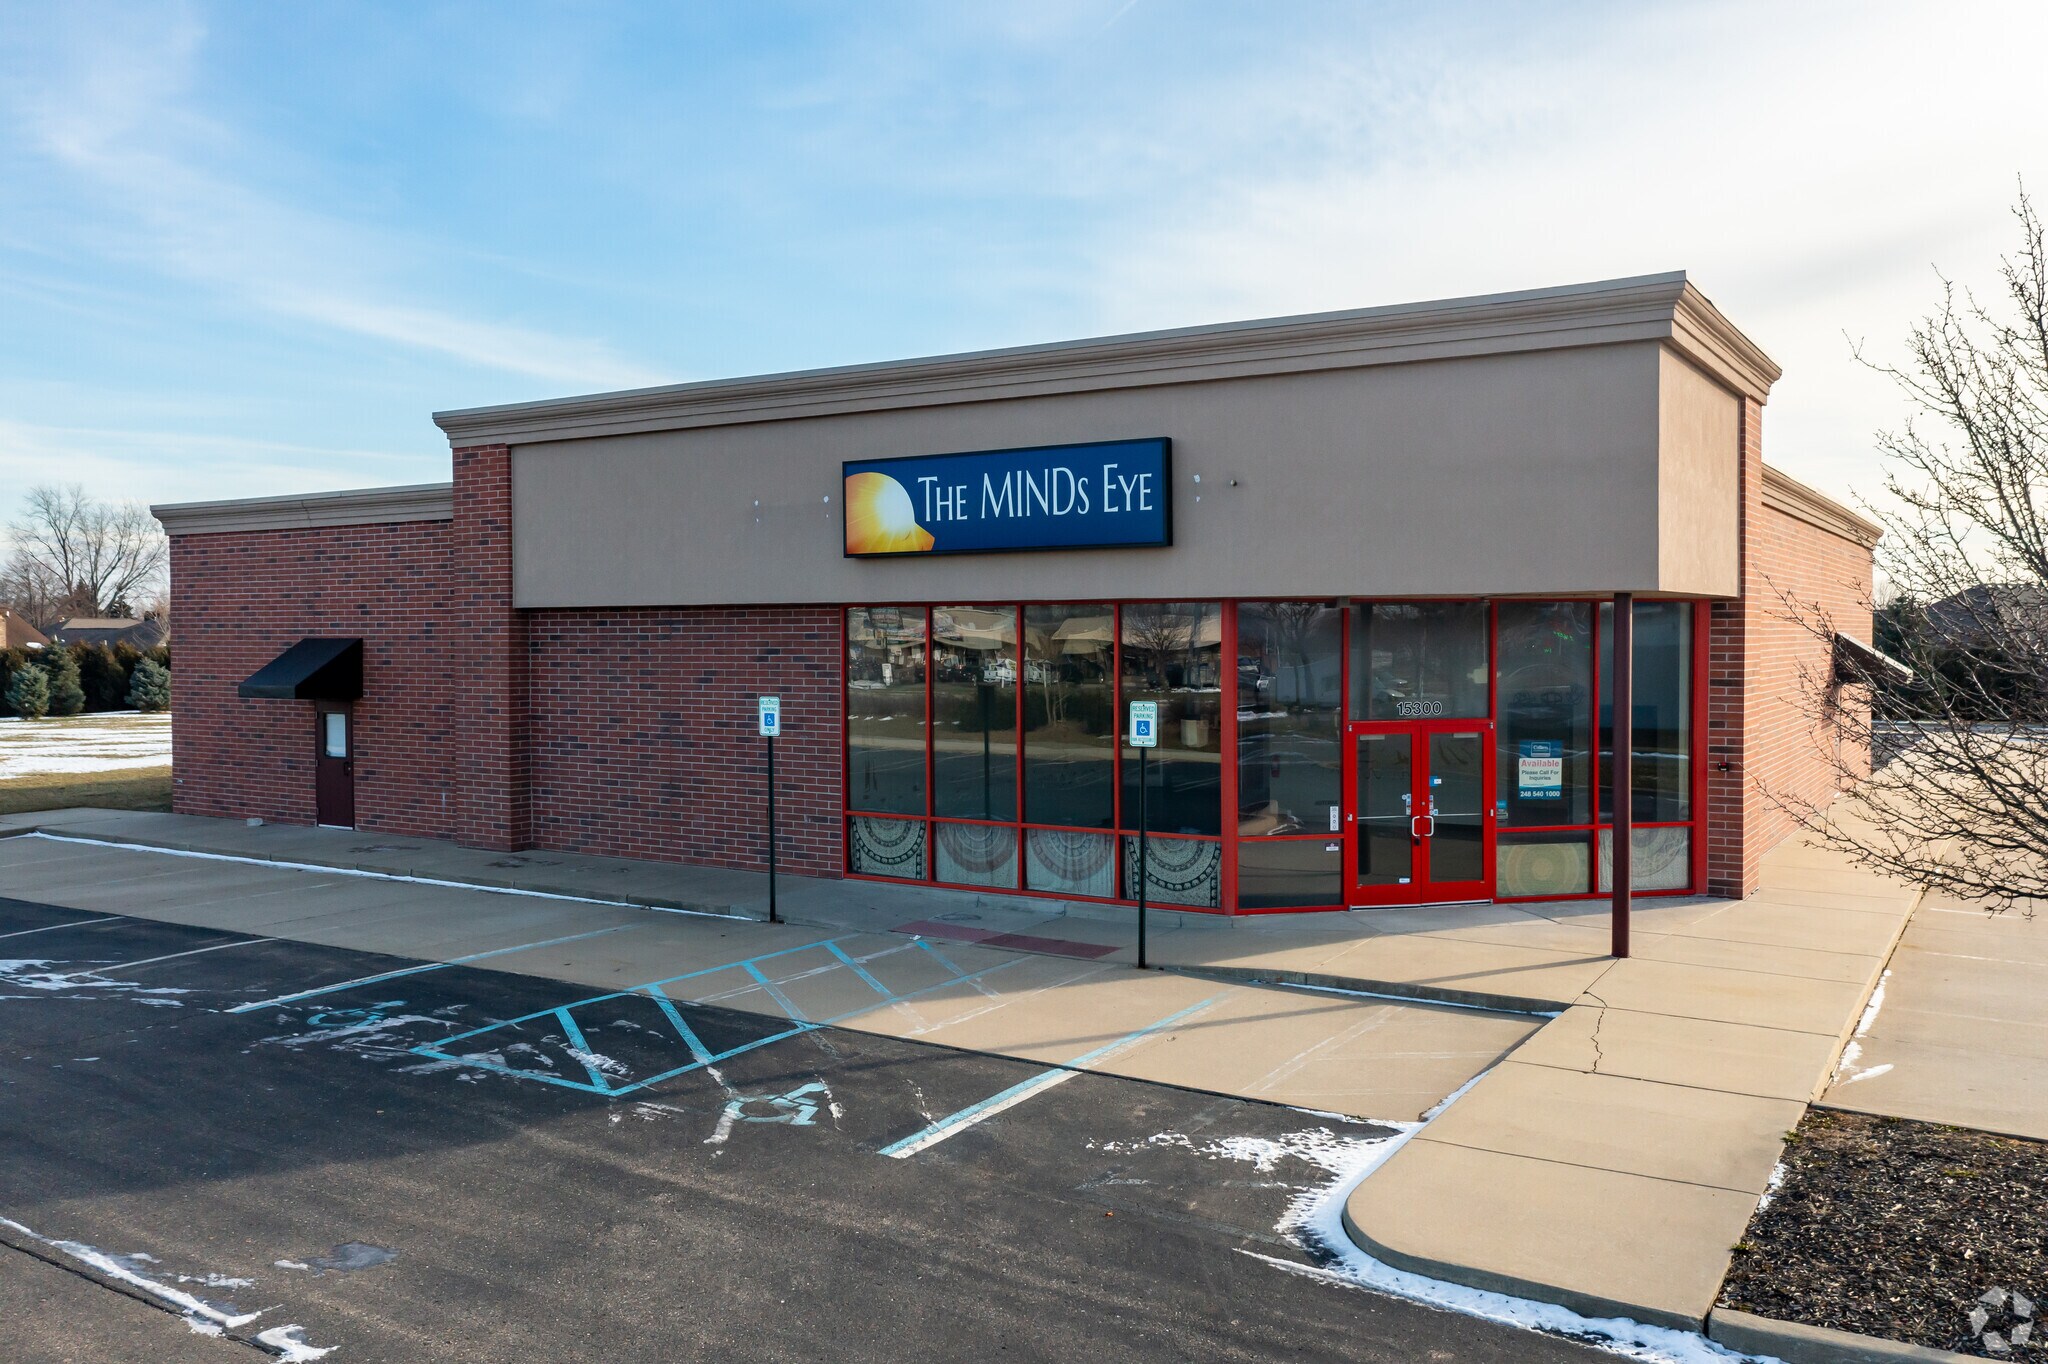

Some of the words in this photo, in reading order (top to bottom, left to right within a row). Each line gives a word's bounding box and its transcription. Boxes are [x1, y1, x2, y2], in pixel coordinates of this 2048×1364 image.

[917, 476, 968, 522] THE
[1103, 463, 1153, 513] EYE
[1396, 700, 1443, 716] 15300
